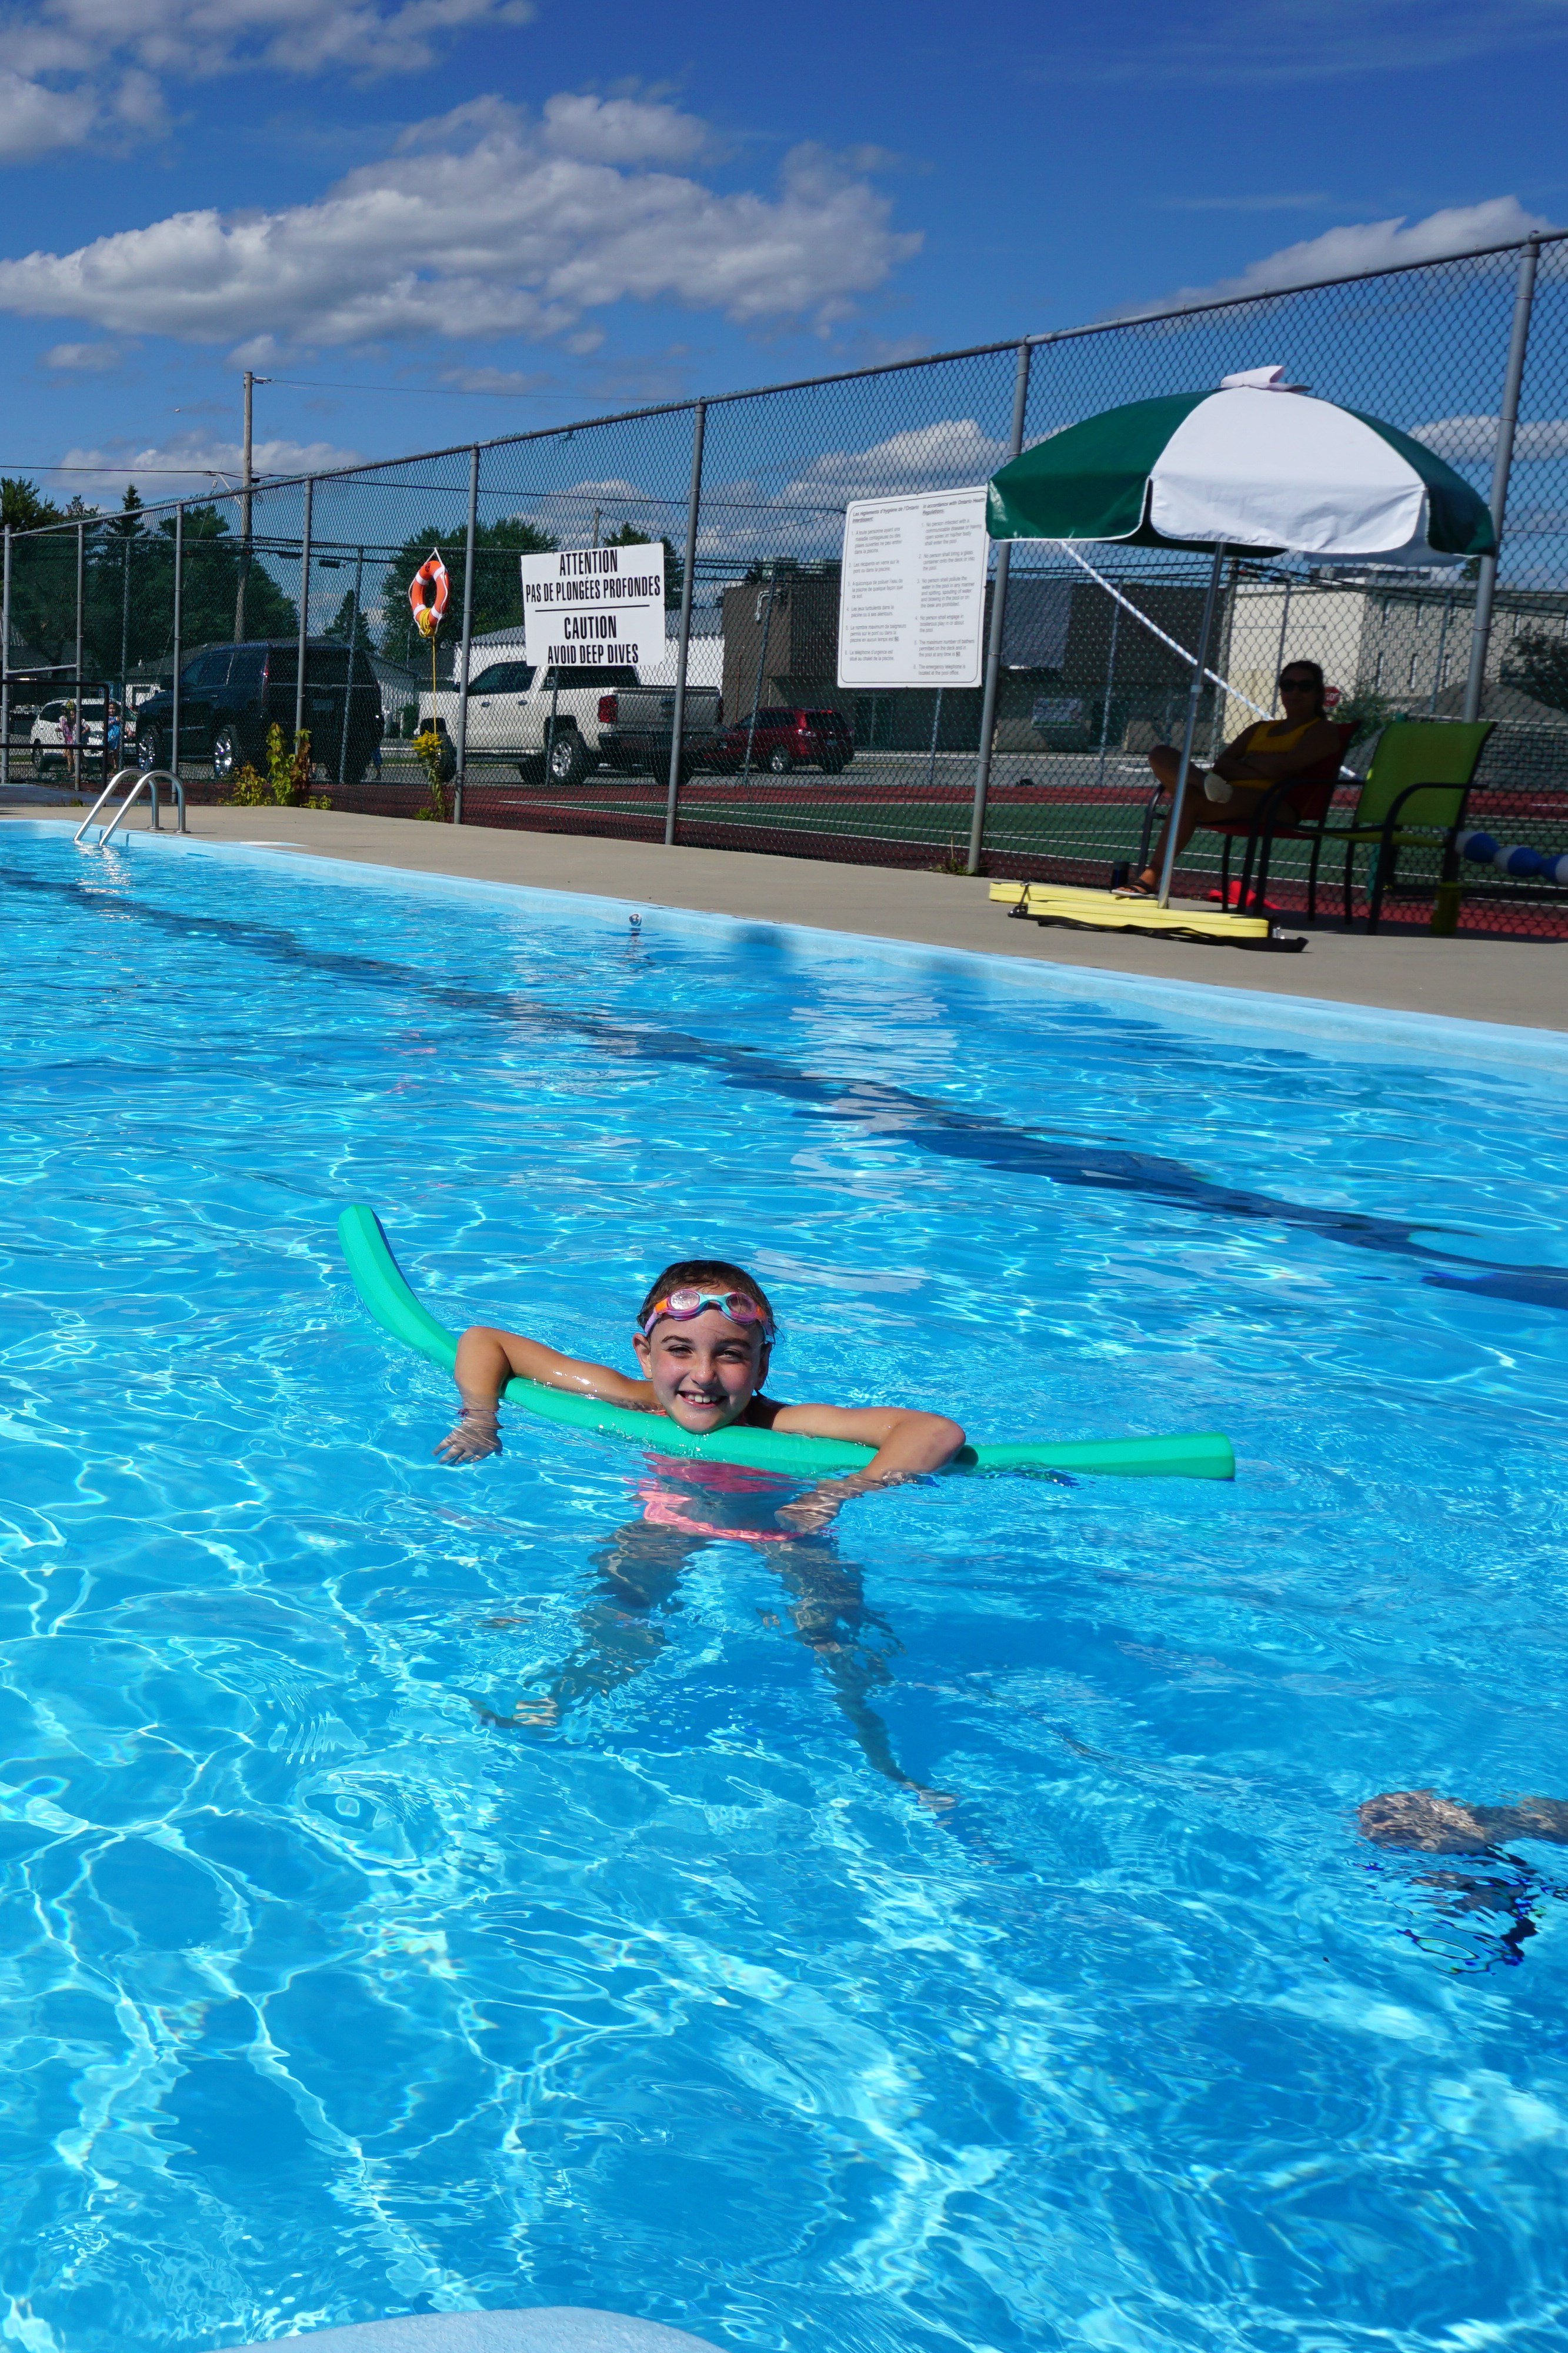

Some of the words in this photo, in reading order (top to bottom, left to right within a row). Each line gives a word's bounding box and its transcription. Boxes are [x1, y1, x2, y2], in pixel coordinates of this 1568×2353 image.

[560, 549, 618, 576] ATTENTION
[526, 584, 541, 602] PAS
[544, 583, 553, 602] DE
[556, 576, 600, 601] PLONGÉES
[603, 575, 660, 599] PROFONDES
[564, 615, 617, 639] CAUTION
[548, 645, 576, 664] AVOID
[580, 645, 604, 664] DEEP
[608, 644, 639, 664] DIVES
